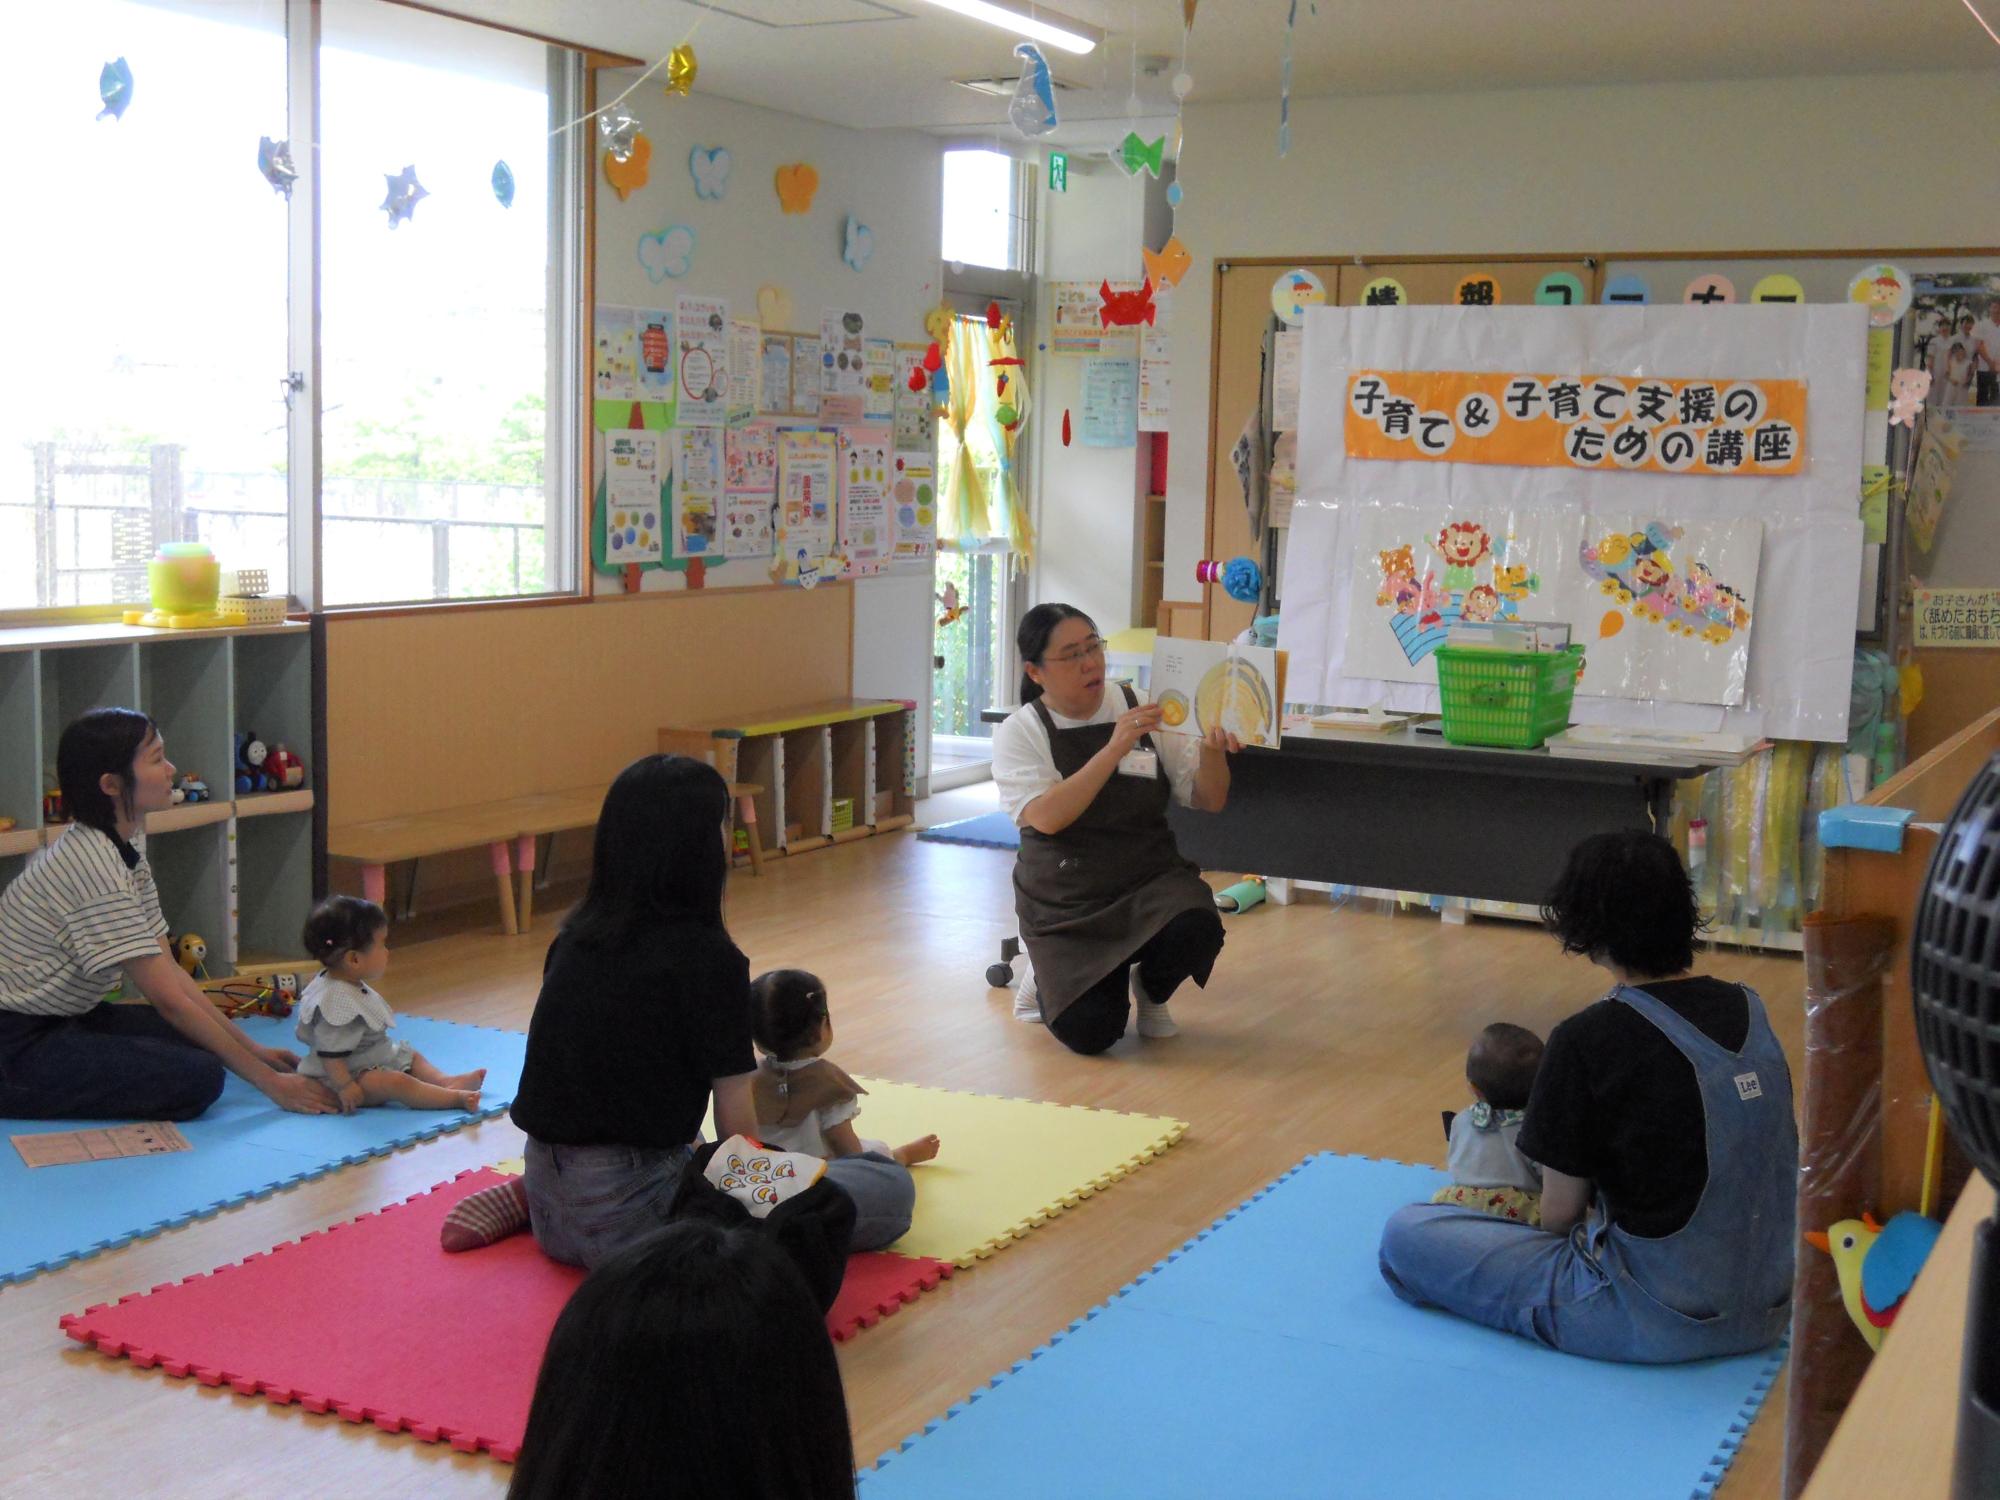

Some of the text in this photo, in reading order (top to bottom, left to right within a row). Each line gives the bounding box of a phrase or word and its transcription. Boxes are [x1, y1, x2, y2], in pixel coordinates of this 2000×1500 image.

[1570, 424, 1792, 466] ための講座
[1741, 1080, 1757, 1093] Lee
